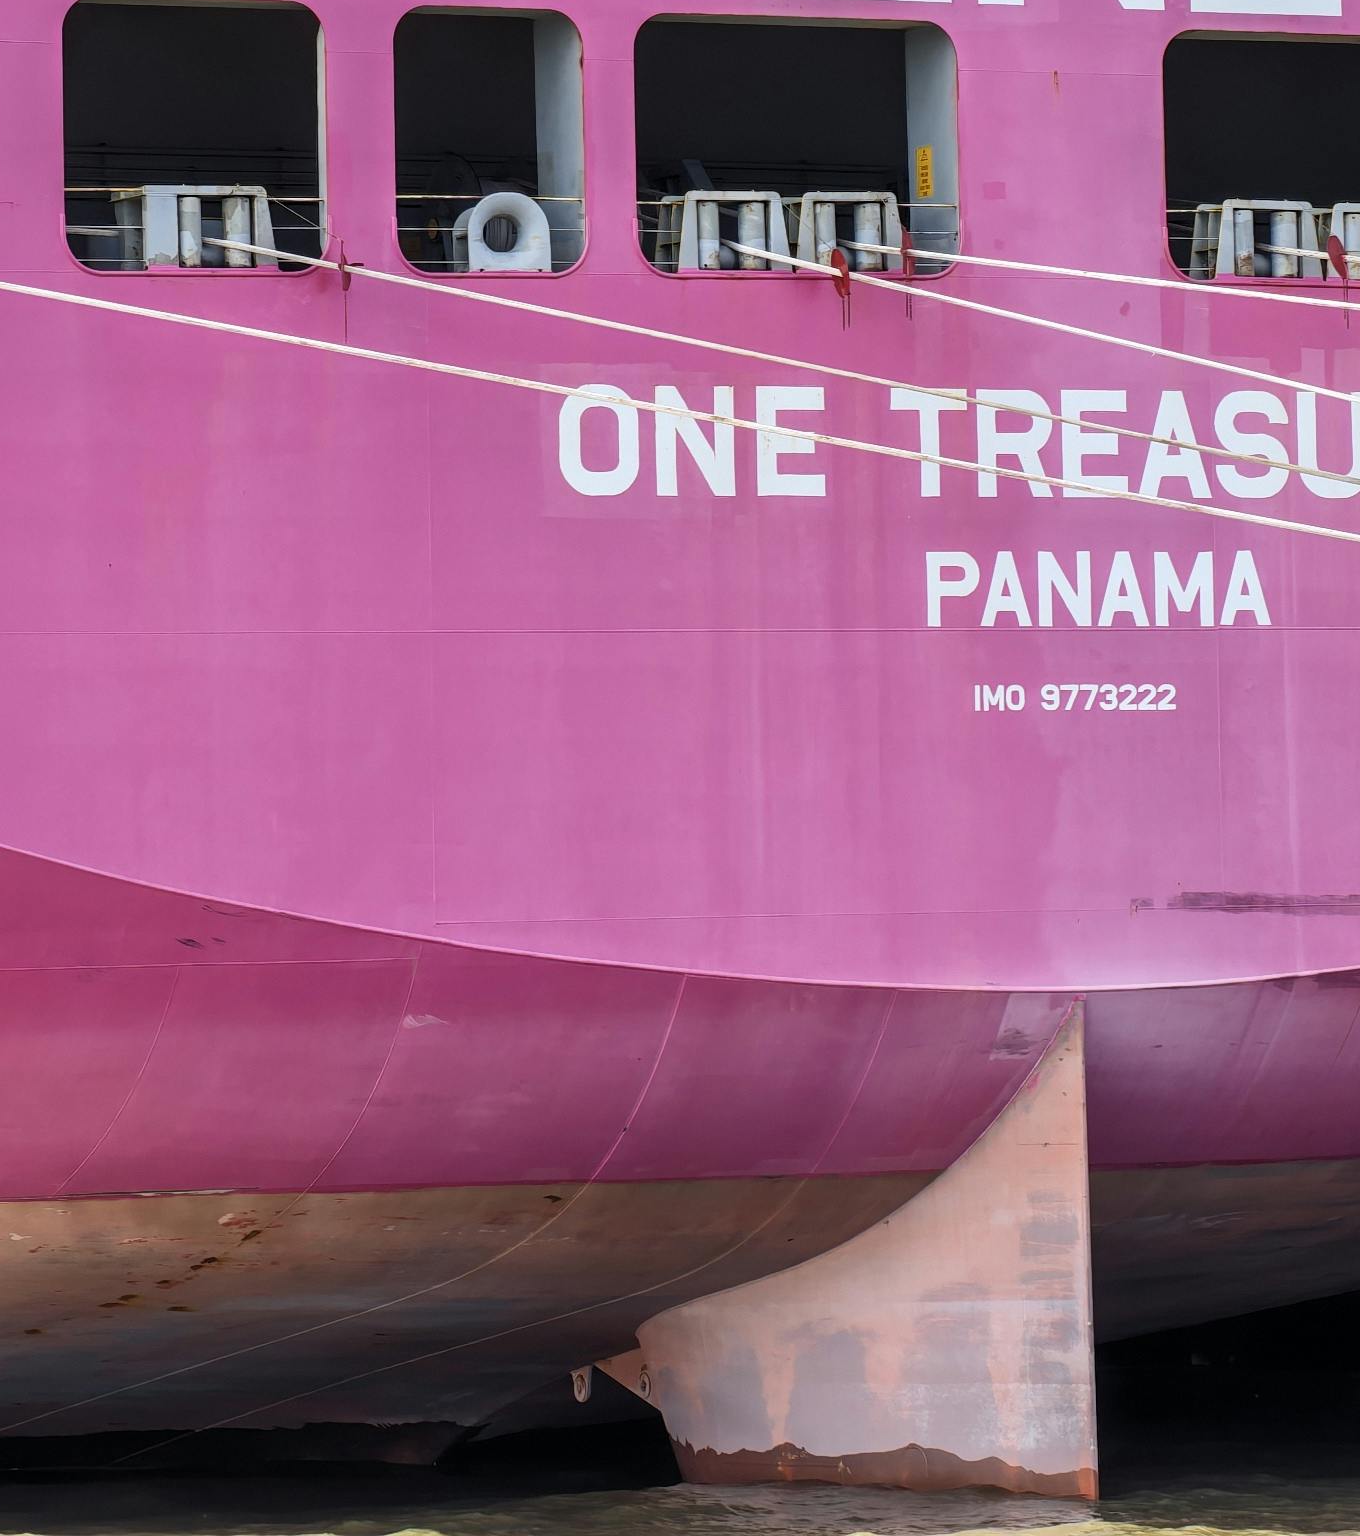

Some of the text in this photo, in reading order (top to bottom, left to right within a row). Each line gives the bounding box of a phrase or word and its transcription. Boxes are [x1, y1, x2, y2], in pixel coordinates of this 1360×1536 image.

[559, 382, 826, 498] ONE
[926, 548, 1272, 628] PANAMA
[972, 683, 1178, 712] IMO 9773222
